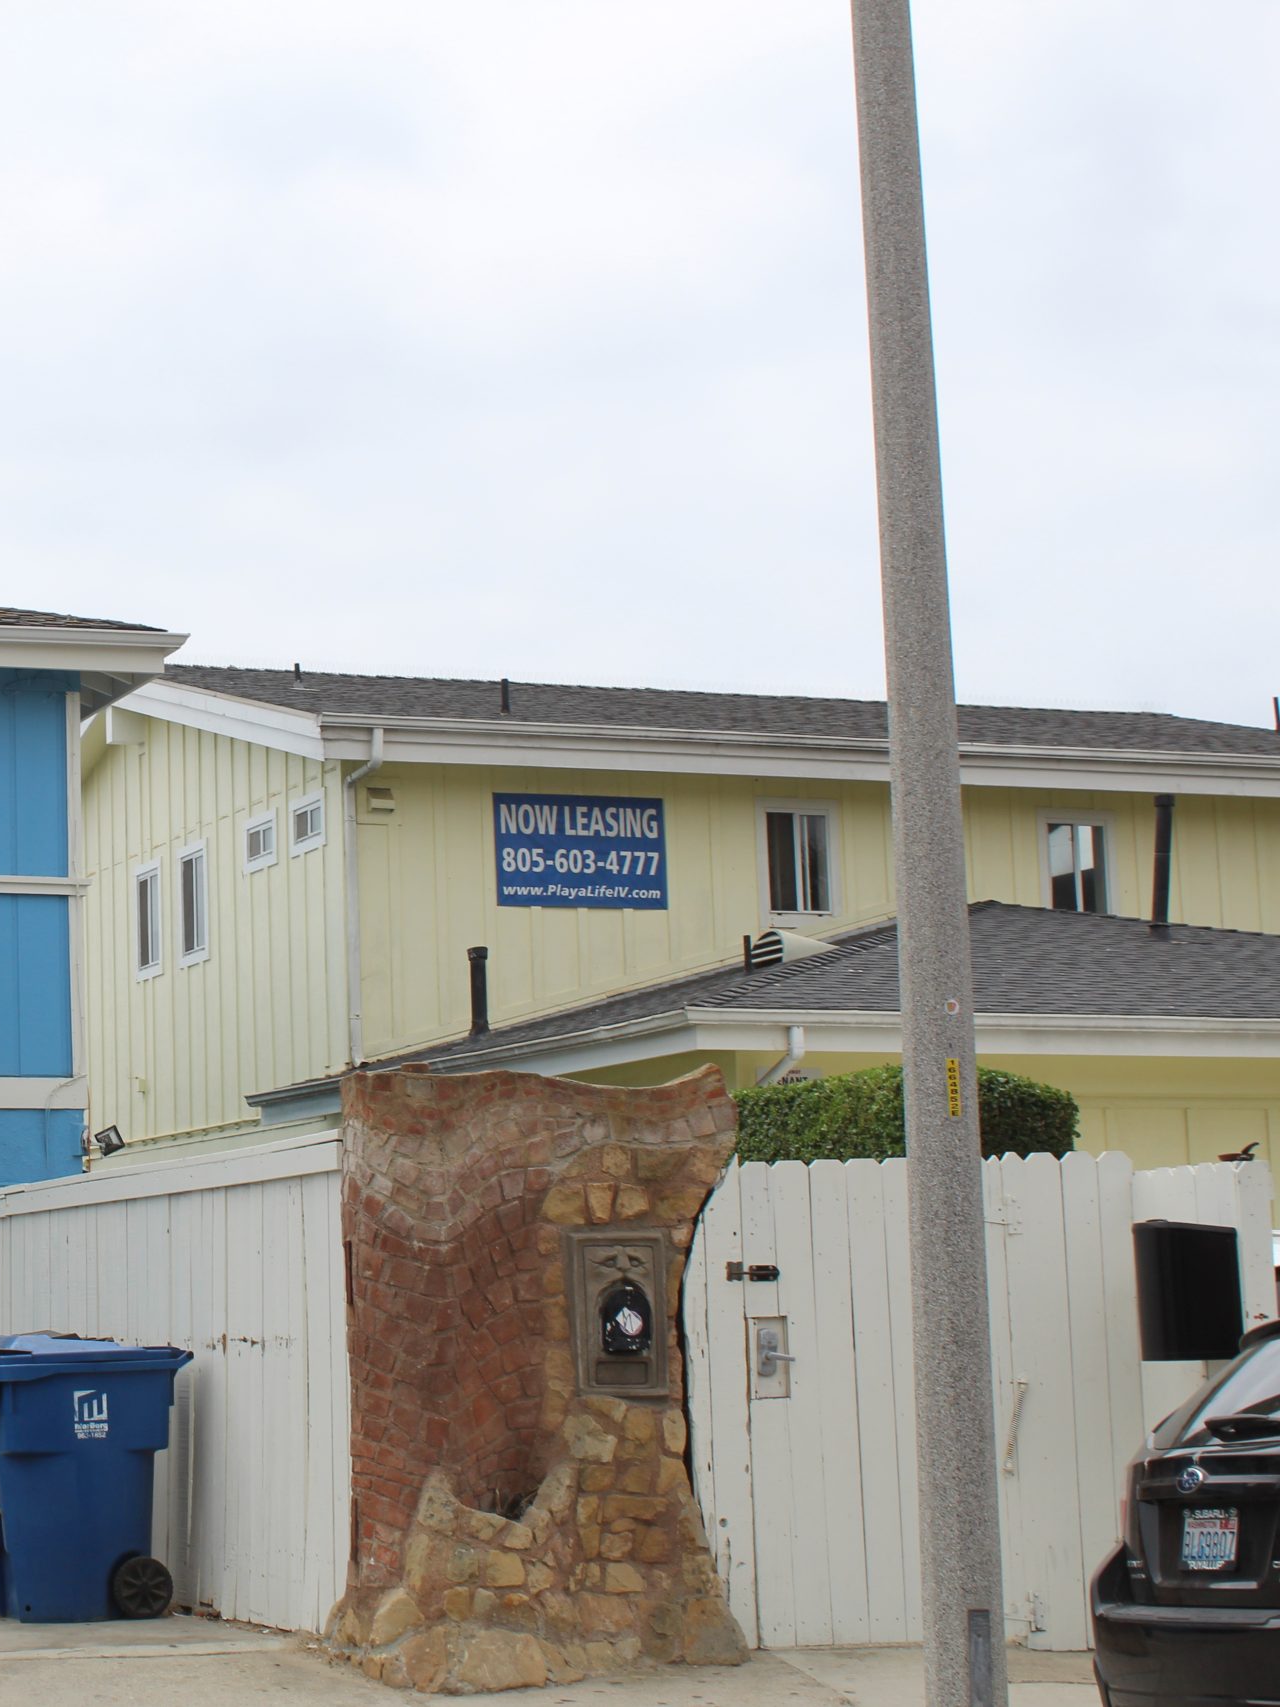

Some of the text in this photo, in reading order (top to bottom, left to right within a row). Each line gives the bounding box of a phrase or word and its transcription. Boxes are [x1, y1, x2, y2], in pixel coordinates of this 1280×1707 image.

[500, 804, 659, 839] NOW LEASING
[502, 848, 660, 876] 805-603-4777
[503, 884, 661, 899] www.PlayaLifeIV.com
